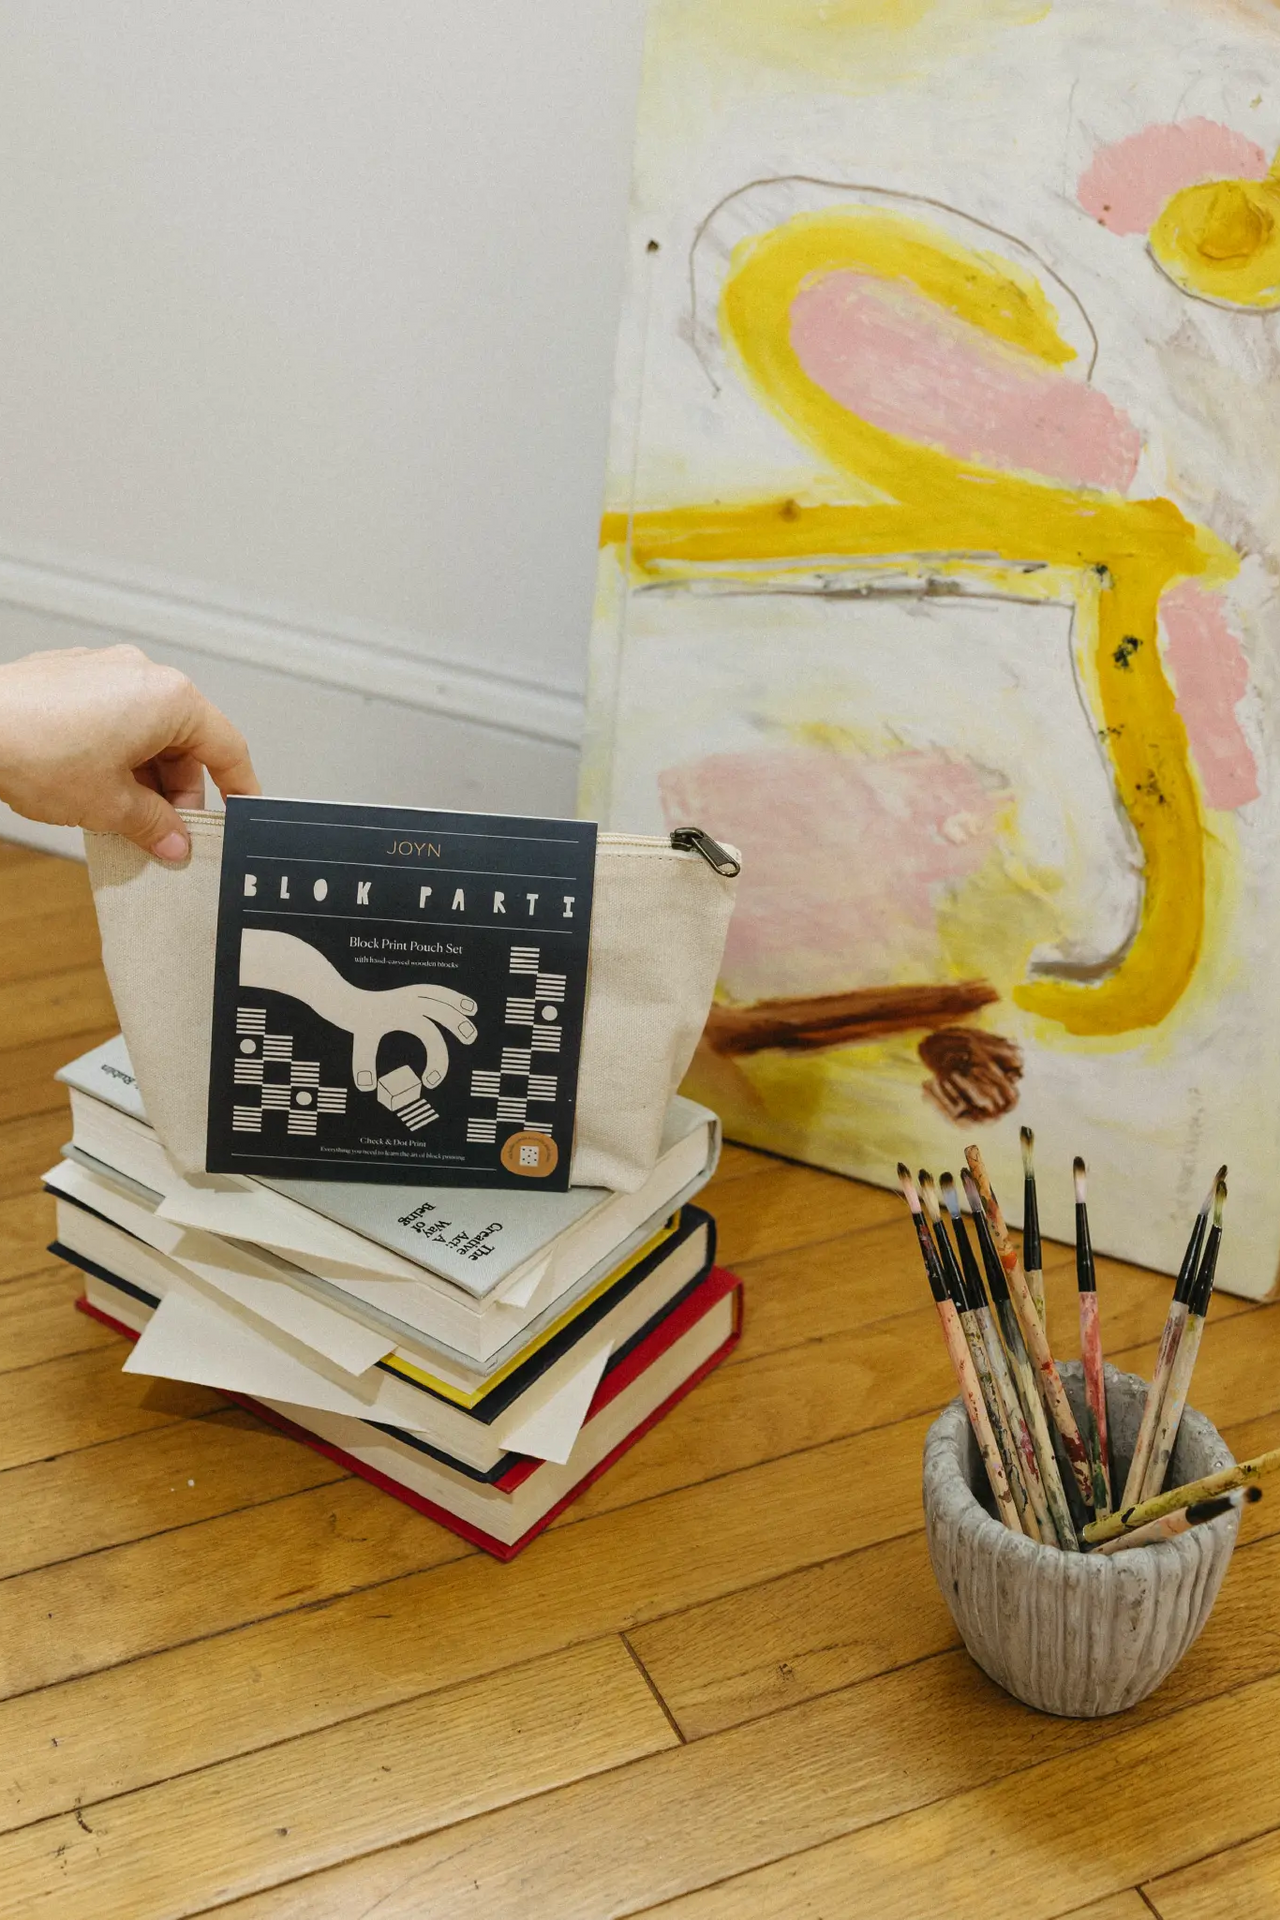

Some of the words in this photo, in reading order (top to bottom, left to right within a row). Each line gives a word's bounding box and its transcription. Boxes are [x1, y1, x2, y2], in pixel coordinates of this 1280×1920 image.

[386, 840, 441, 858] JOYN
[243, 873, 372, 905] BLOK
[419, 886, 576, 918] PARTI
[349, 936, 379, 949] Block
[381, 938, 407, 951] Print
[410, 941, 443, 953] Pouch
[445, 943, 463, 955] Set
[369, 956, 410, 966] hand-carved
[411, 959, 437, 968] wooden
[437, 961, 459, 969] blocks
[320, 1146, 352, 1154] Everything
[359, 1137, 384, 1145] Check
[384, 1138, 392, 1146] &
[393, 1138, 408, 1147] Dot
[409, 1140, 427, 1148] Print
[397, 1202, 437, 1227] Being
[410, 1221, 426, 1234] of
[421, 1220, 453, 1239] Way
[431, 1233, 447, 1244] A
[445, 1230, 470, 1249] Act:
[456, 1222, 504, 1256] Creative
[468, 1244, 496, 1261] The
